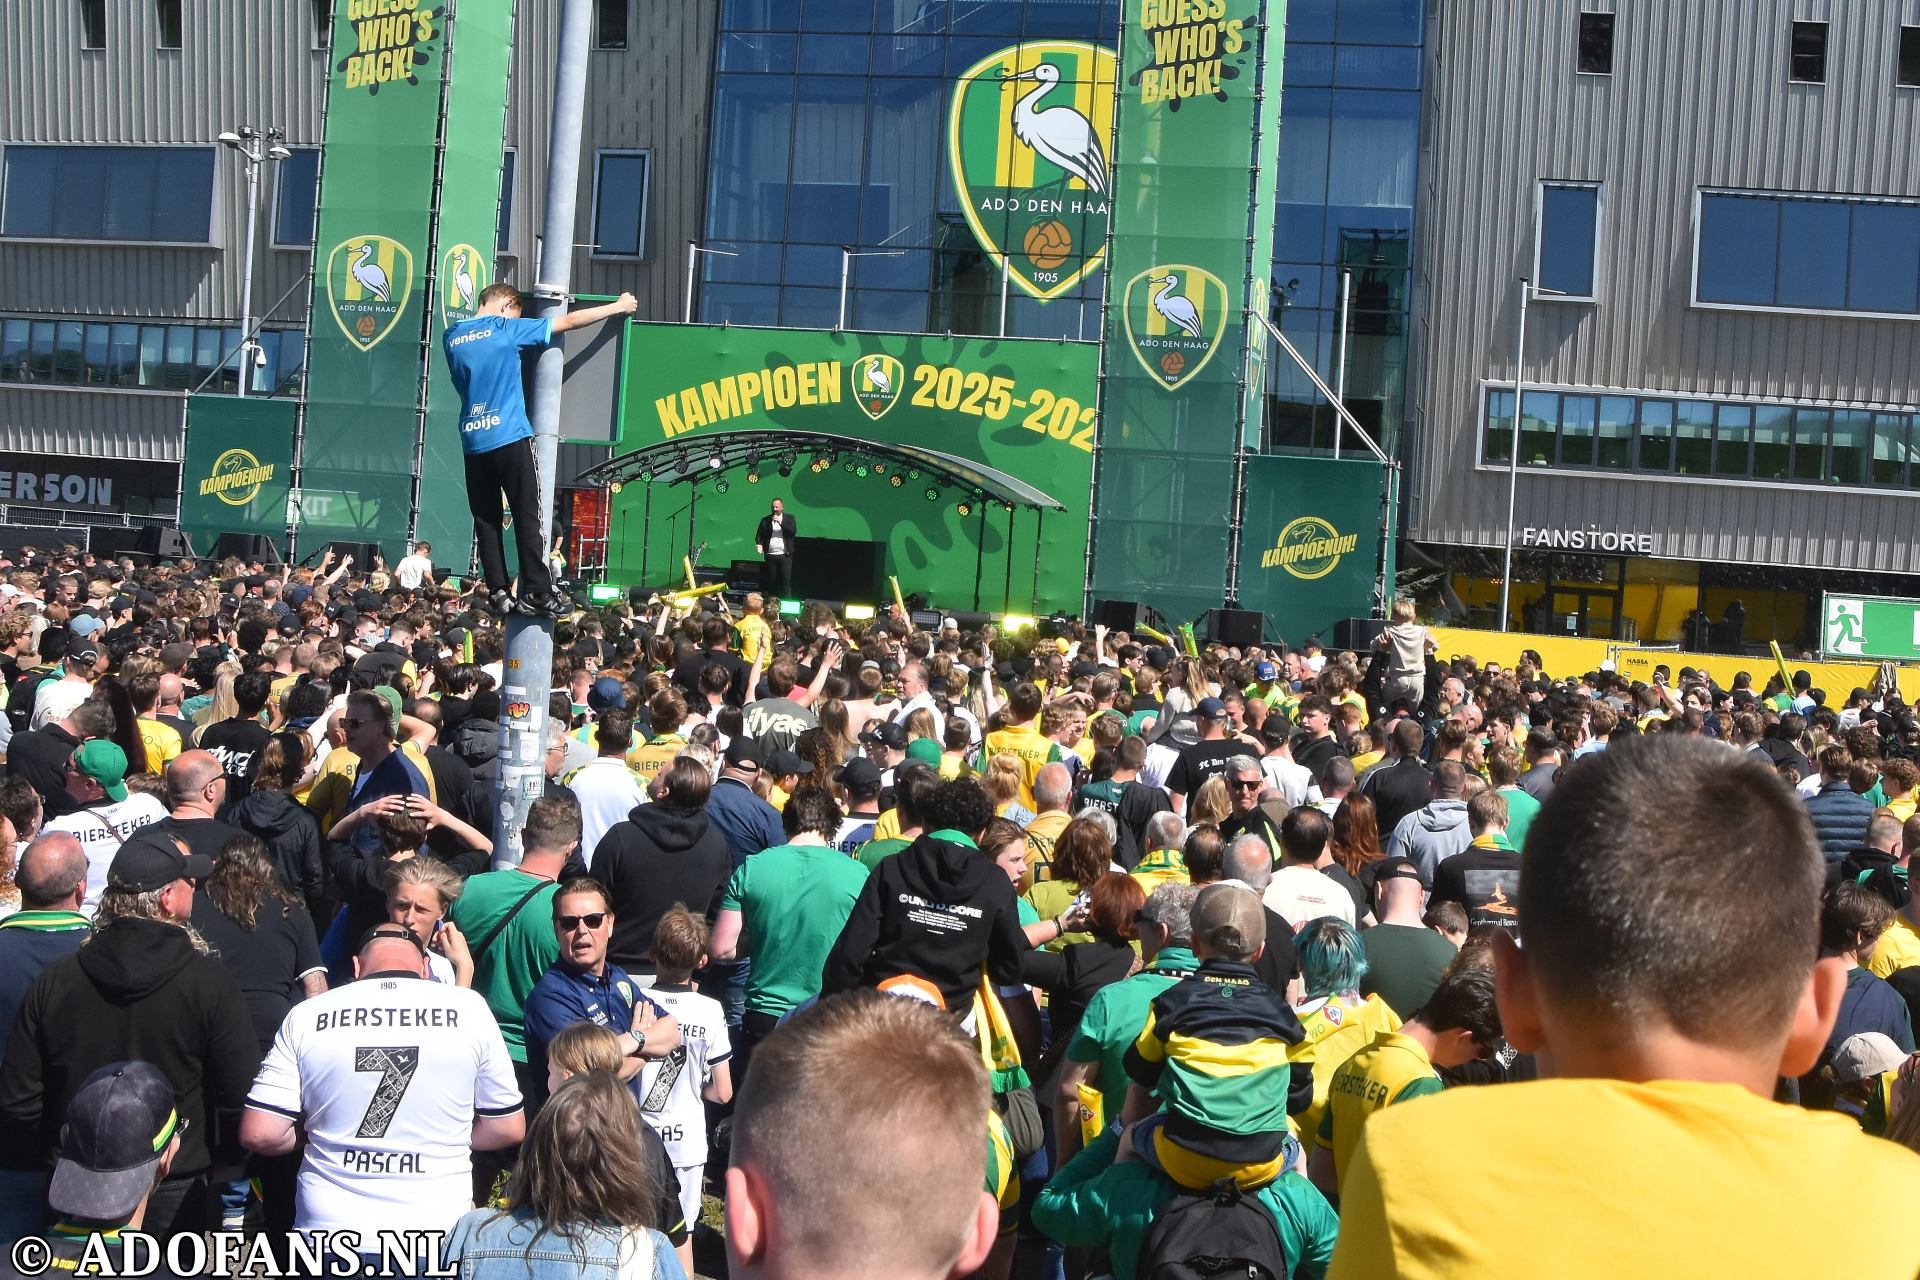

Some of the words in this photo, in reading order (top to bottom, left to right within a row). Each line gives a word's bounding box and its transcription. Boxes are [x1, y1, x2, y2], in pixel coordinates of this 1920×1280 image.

[1141, 0, 1226, 30] GUESS
[358, 9, 433, 53] WHO'S
[1154, 19, 1243, 65] WHO'S
[346, 46, 415, 89] BACK!
[1141, 59, 1222, 104] BACK!
[981, 197, 1019, 212] ADO
[1028, 199, 1062, 213] DEN
[1071, 200, 1109, 215] HAA
[1033, 272, 1058, 283] 1905
[339, 304, 355, 312] ADO
[1139, 339, 1159, 349] ADO
[1162, 340, 1181, 349] DEN
[1183, 340, 1209, 350] HAAG
[655, 361, 841, 439] KAMPIOEN
[911, 364, 1098, 454] 2025-202
[199, 463, 275, 496] KAMPIOENUH!
[1261, 533, 1358, 568] KAMPIOENUH!
[1522, 527, 1652, 553] FANSTORE
[1083, 797, 1119, 813] BIERST
[380, 981, 398, 990] 1905
[316, 1007, 459, 1032] BIERSTEKER
[355, 1046, 420, 1138] 7
[641, 1045, 688, 1112] 7
[343, 1149, 426, 1175] PASCAL
